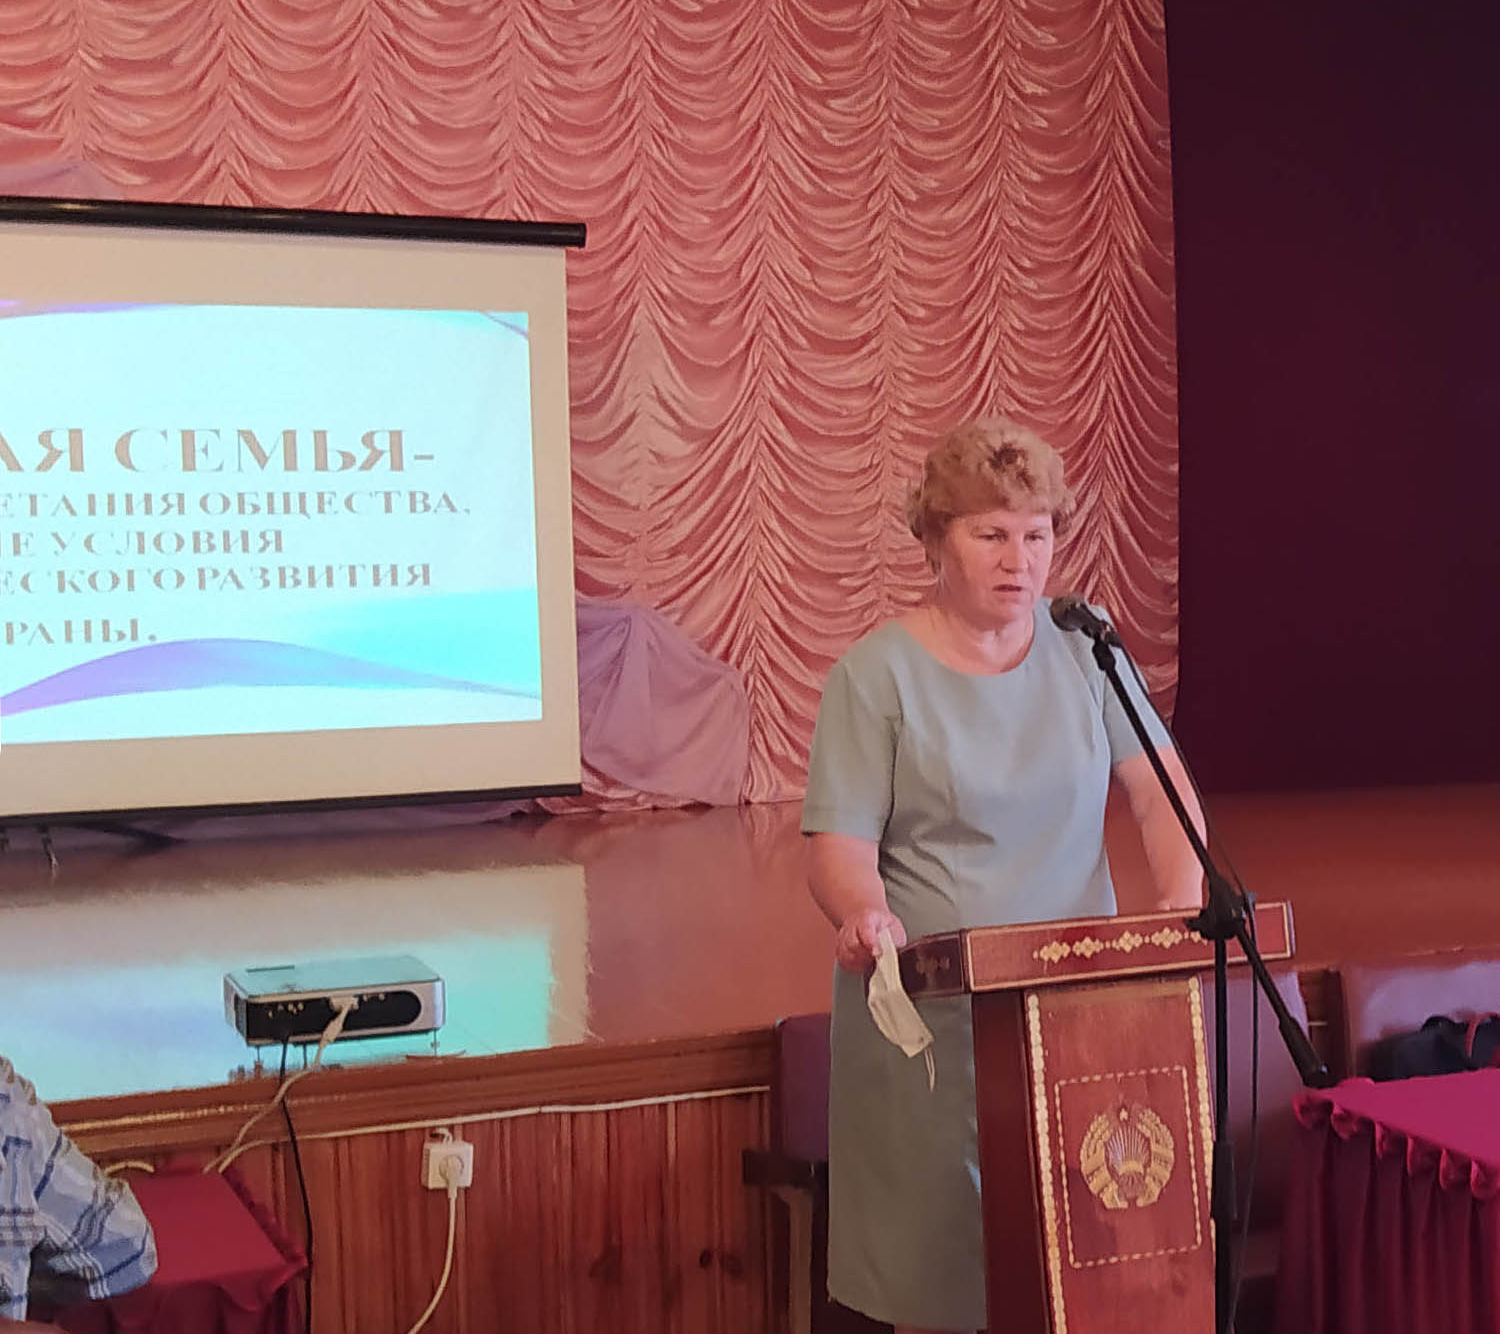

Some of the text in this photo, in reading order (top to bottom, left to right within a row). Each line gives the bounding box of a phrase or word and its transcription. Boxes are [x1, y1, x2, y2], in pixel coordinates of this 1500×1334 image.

[114, 428, 434, 473] СЕМЬЯ-
[199, 490, 471, 519] ОБЩЕСТВА,
[50, 529, 283, 556] УСЛОВИЯ
[196, 563, 430, 591] РАЗВИТИЯ
